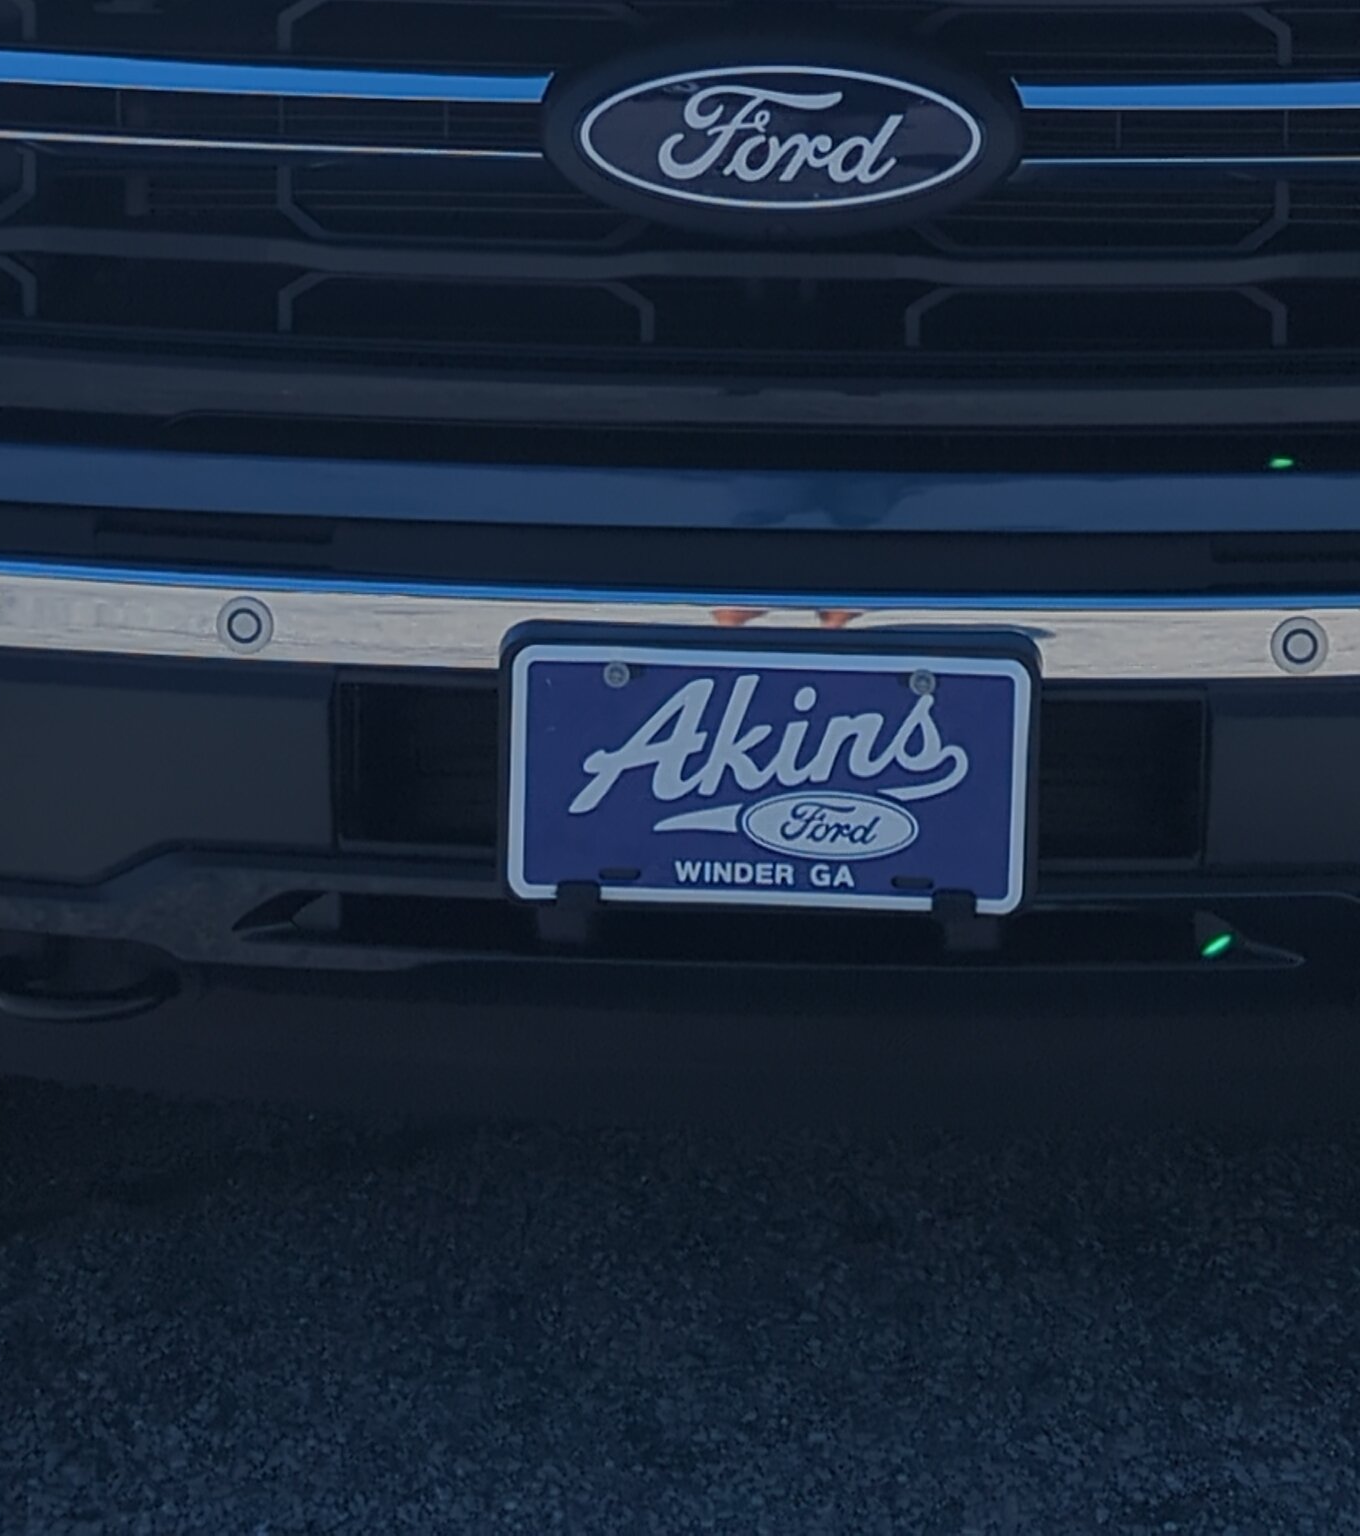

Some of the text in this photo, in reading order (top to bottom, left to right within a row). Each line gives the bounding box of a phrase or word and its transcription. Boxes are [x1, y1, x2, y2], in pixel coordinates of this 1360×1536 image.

[658, 84, 904, 184] Ford
[568, 673, 970, 814] Akins
[779, 801, 882, 846] Ford
[674, 859, 855, 889] WINDER GA
